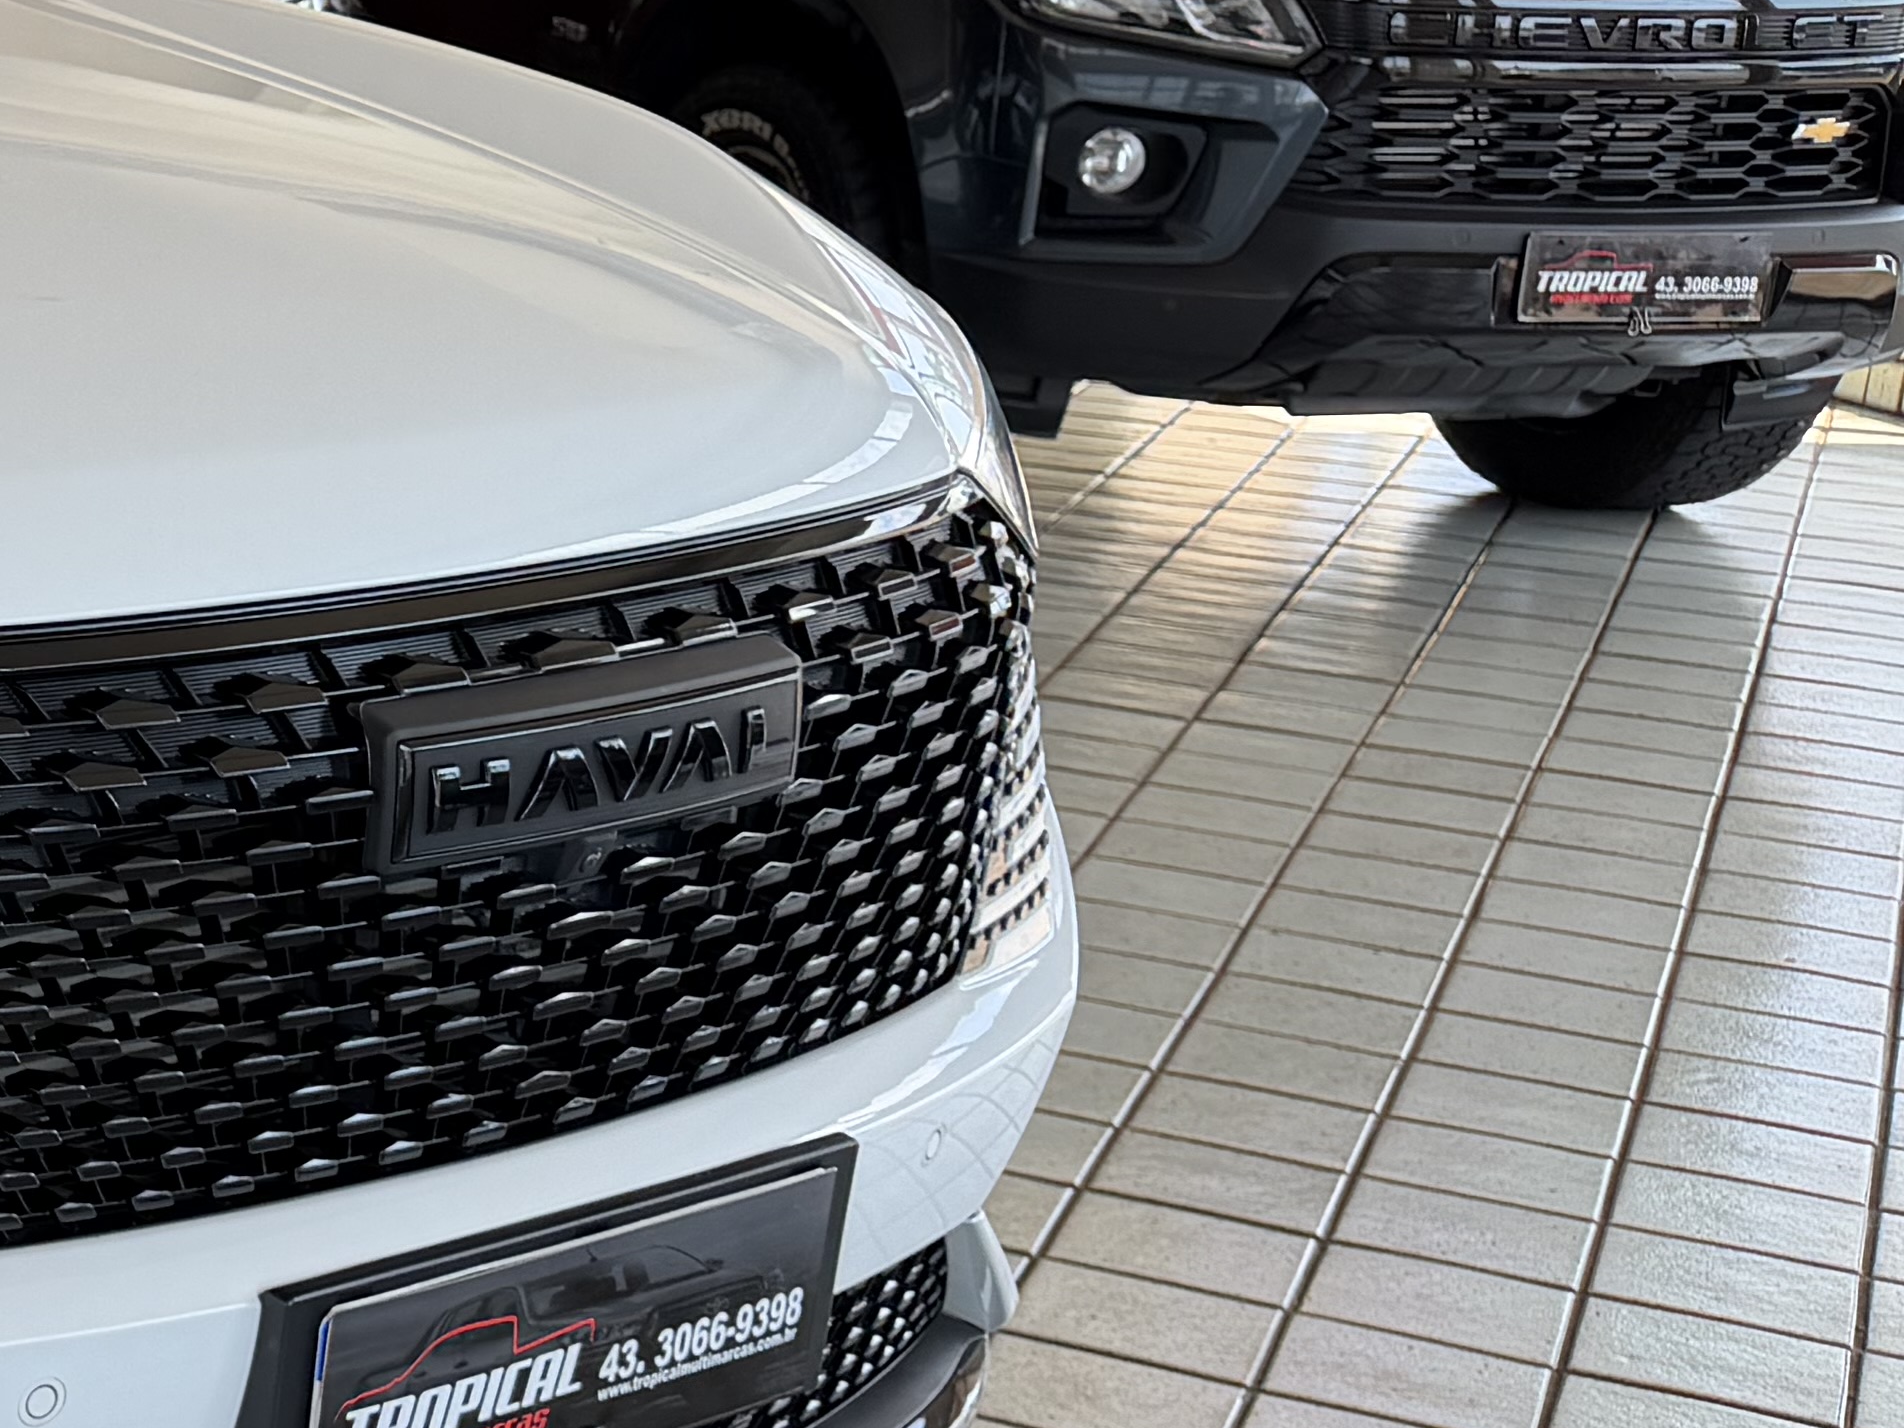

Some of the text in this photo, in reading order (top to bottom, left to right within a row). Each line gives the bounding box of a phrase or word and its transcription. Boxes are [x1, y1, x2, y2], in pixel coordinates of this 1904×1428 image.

[1389, 10, 1884, 50] CHEVROLET
[1536, 270, 1648, 293] TROPICAL
[1683, 275, 1759, 293] 3066-9398
[427, 705, 792, 835] HAVAL
[597, 1327, 798, 1402] www.tropicalmultimarcas.com.br
[654, 1286, 805, 1368] 3066-9398
